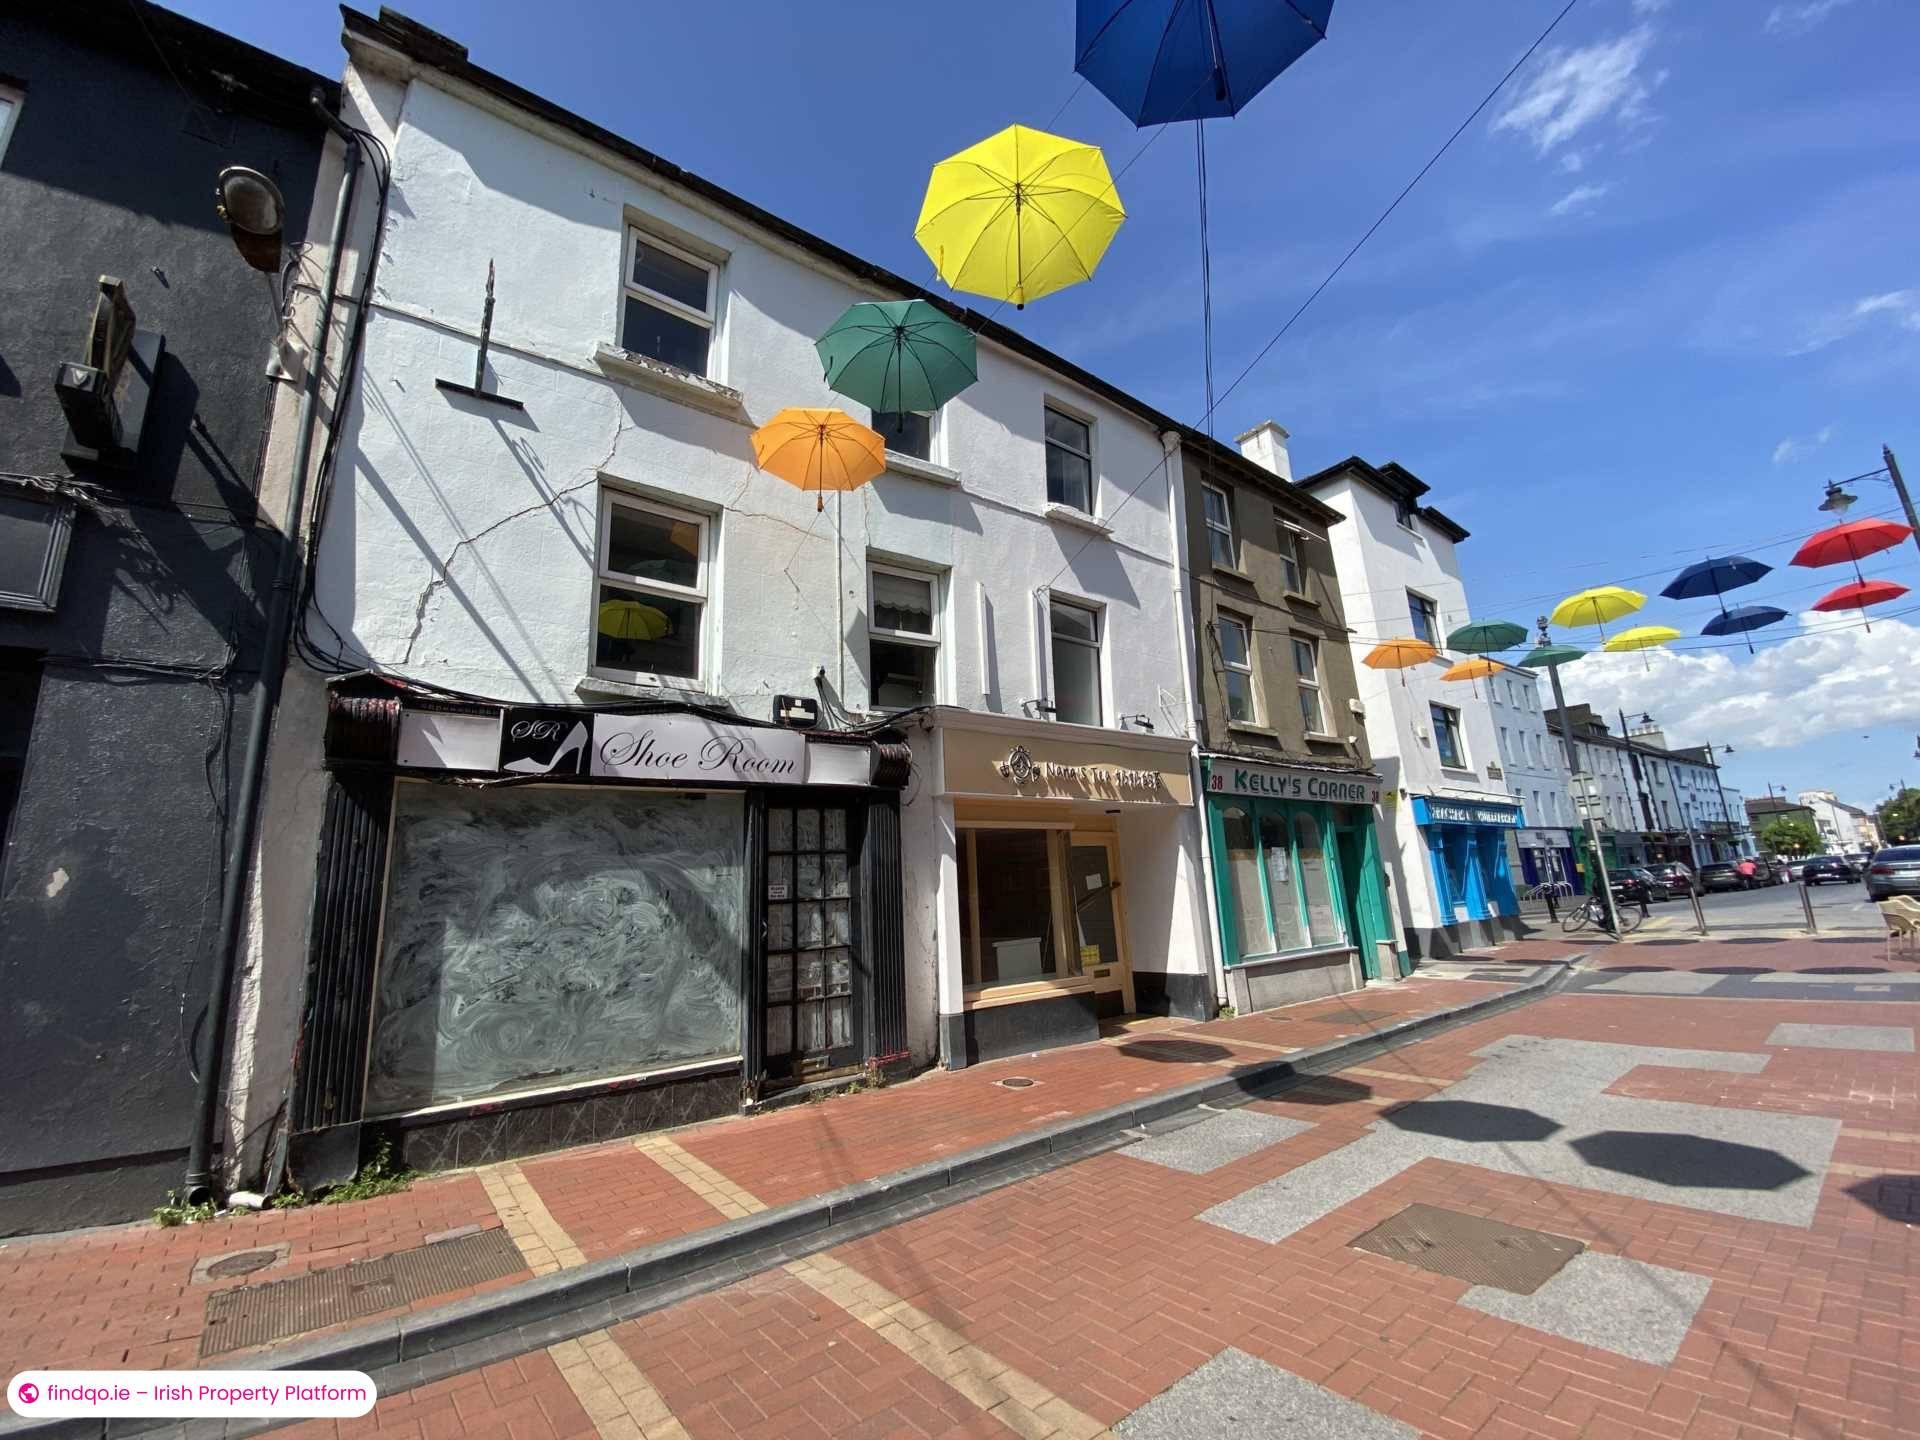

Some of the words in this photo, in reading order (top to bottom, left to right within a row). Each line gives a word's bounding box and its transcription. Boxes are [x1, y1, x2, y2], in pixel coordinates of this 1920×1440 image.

[510, 720, 564, 742] SR
[600, 729, 688, 770] Shoe
[698, 735, 796, 774] Room
[1211, 775, 1223, 791] 38
[1234, 768, 1300, 795] KELLY'S
[1307, 777, 1366, 800] CORNER
